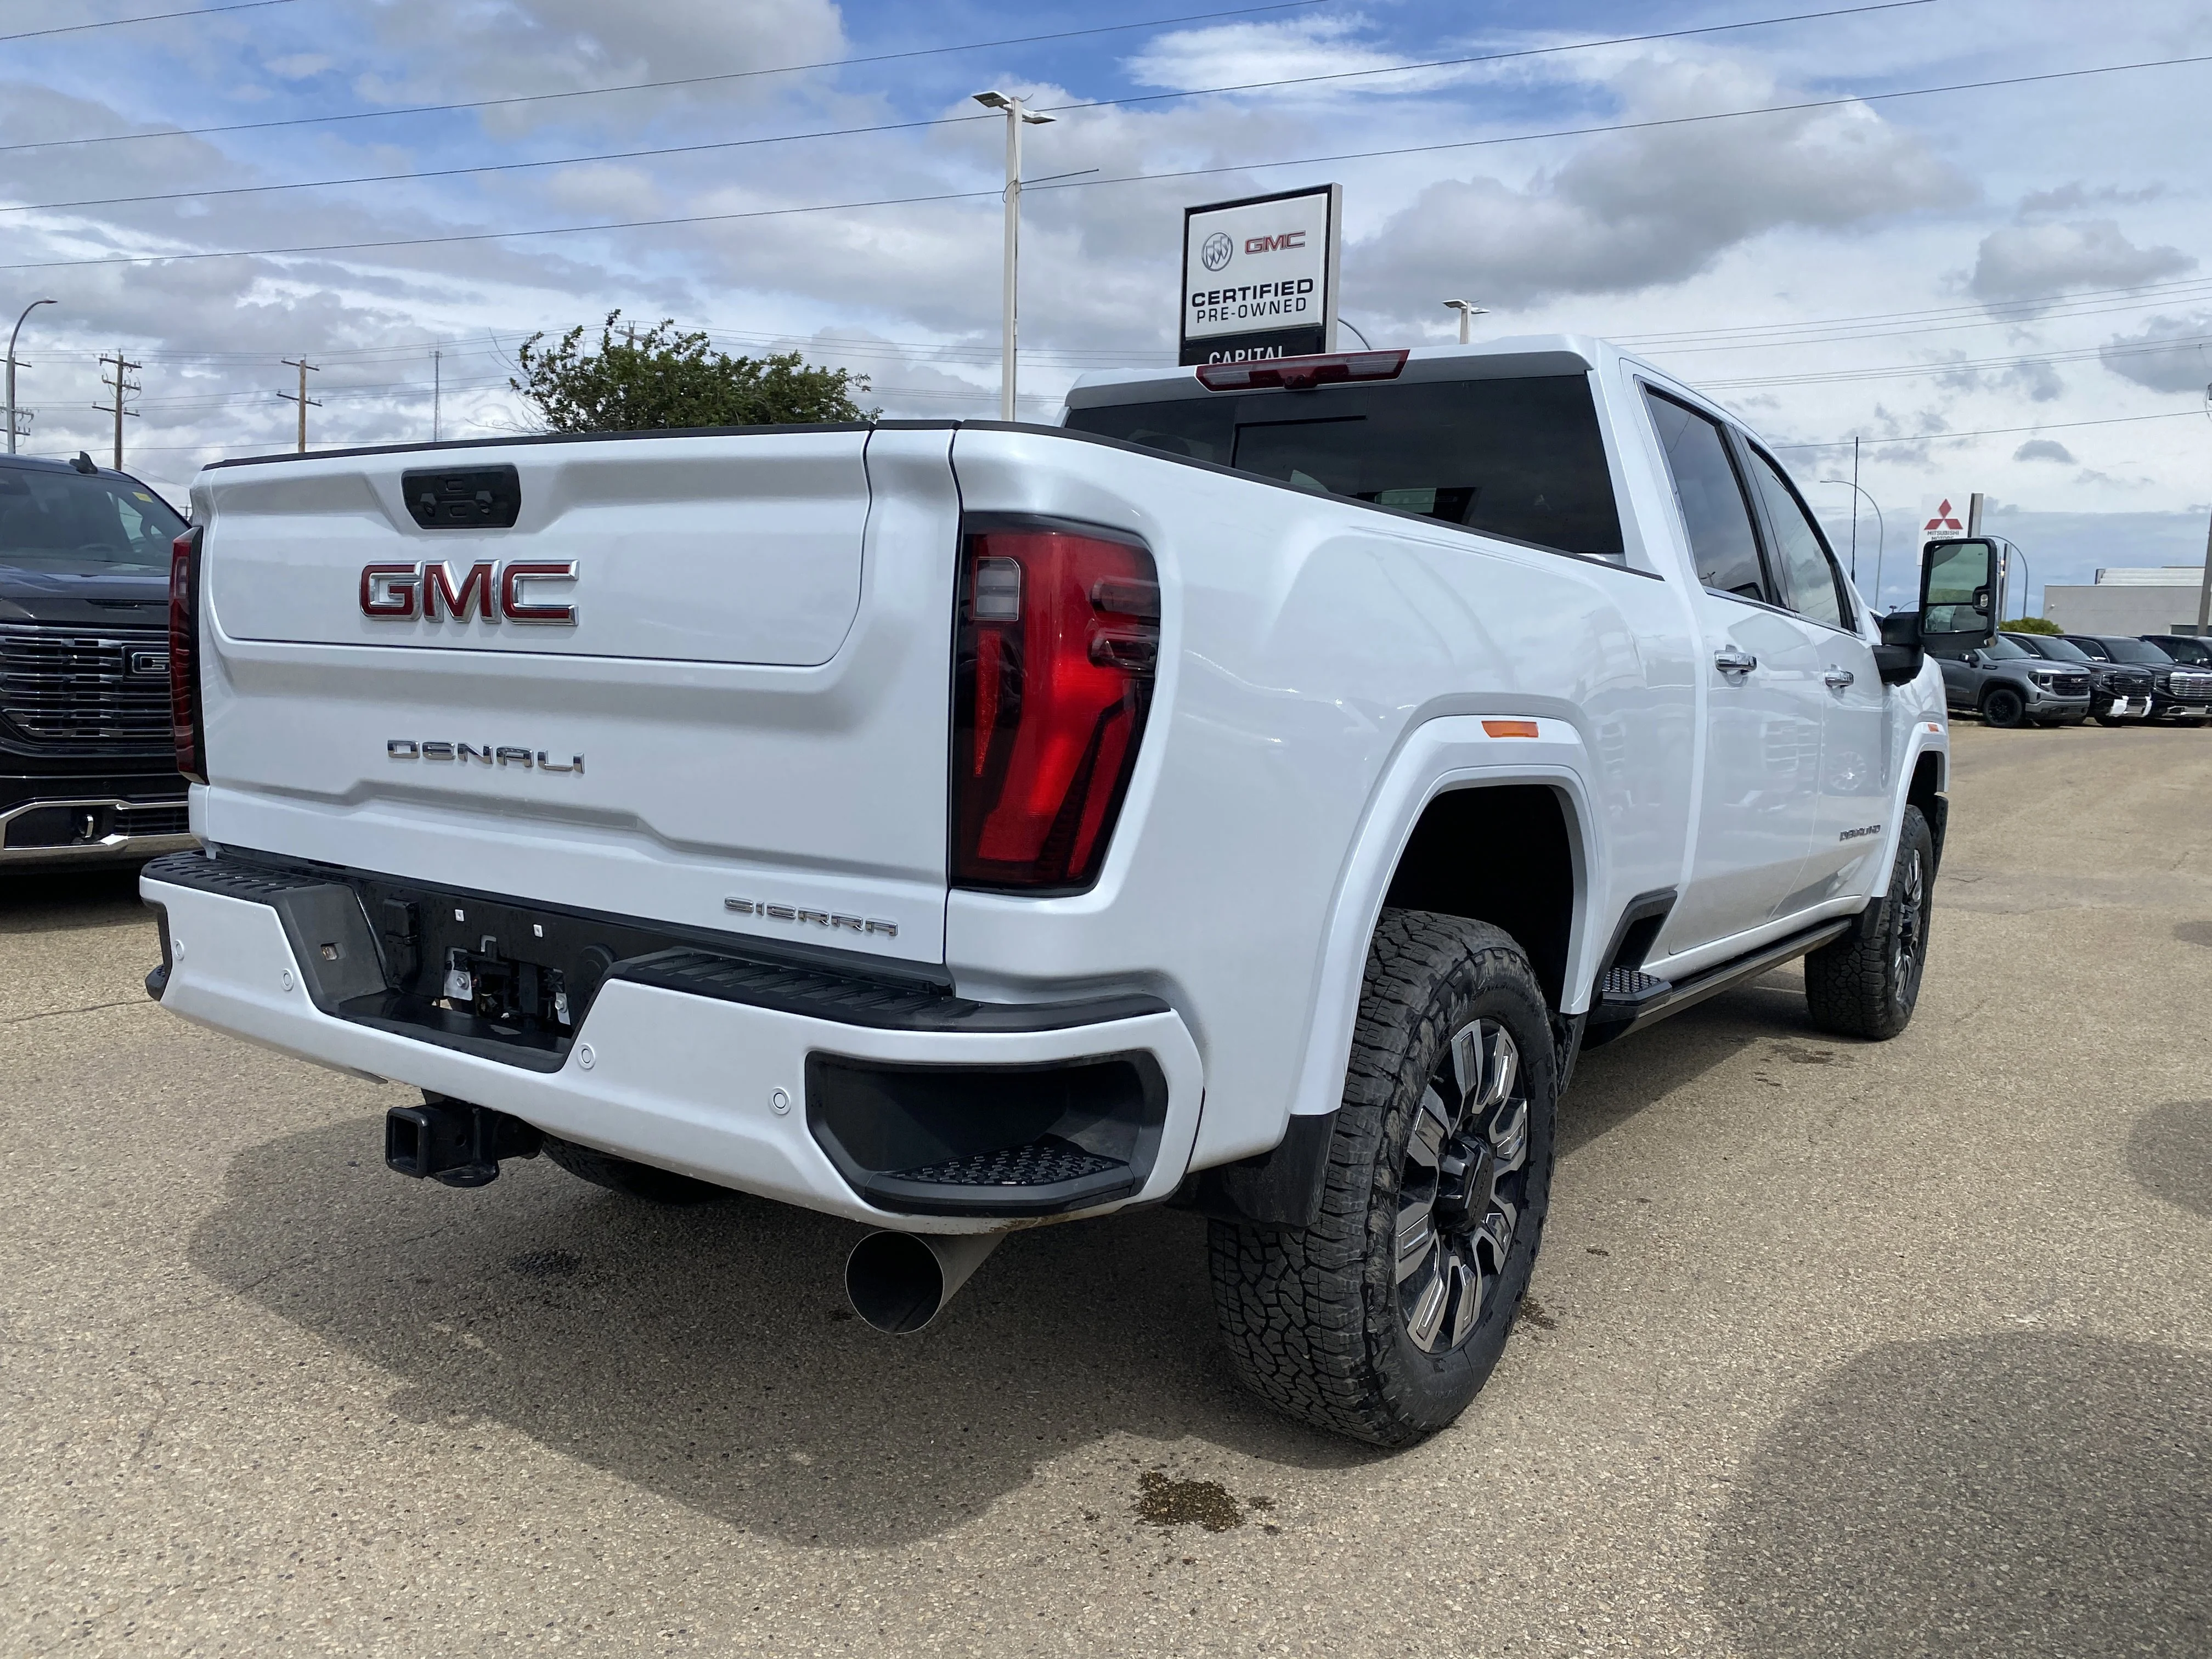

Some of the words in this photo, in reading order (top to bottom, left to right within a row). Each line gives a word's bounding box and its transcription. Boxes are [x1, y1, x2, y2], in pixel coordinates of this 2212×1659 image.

[1245, 230, 1306, 255] GMC
[1192, 278, 1313, 307] CERTIFIED
[1197, 297, 1306, 323] PRE-OWNED
[359, 558, 580, 626] GMC
[387, 739, 585, 774] DENALI
[724, 896, 898, 936] SIERRA
